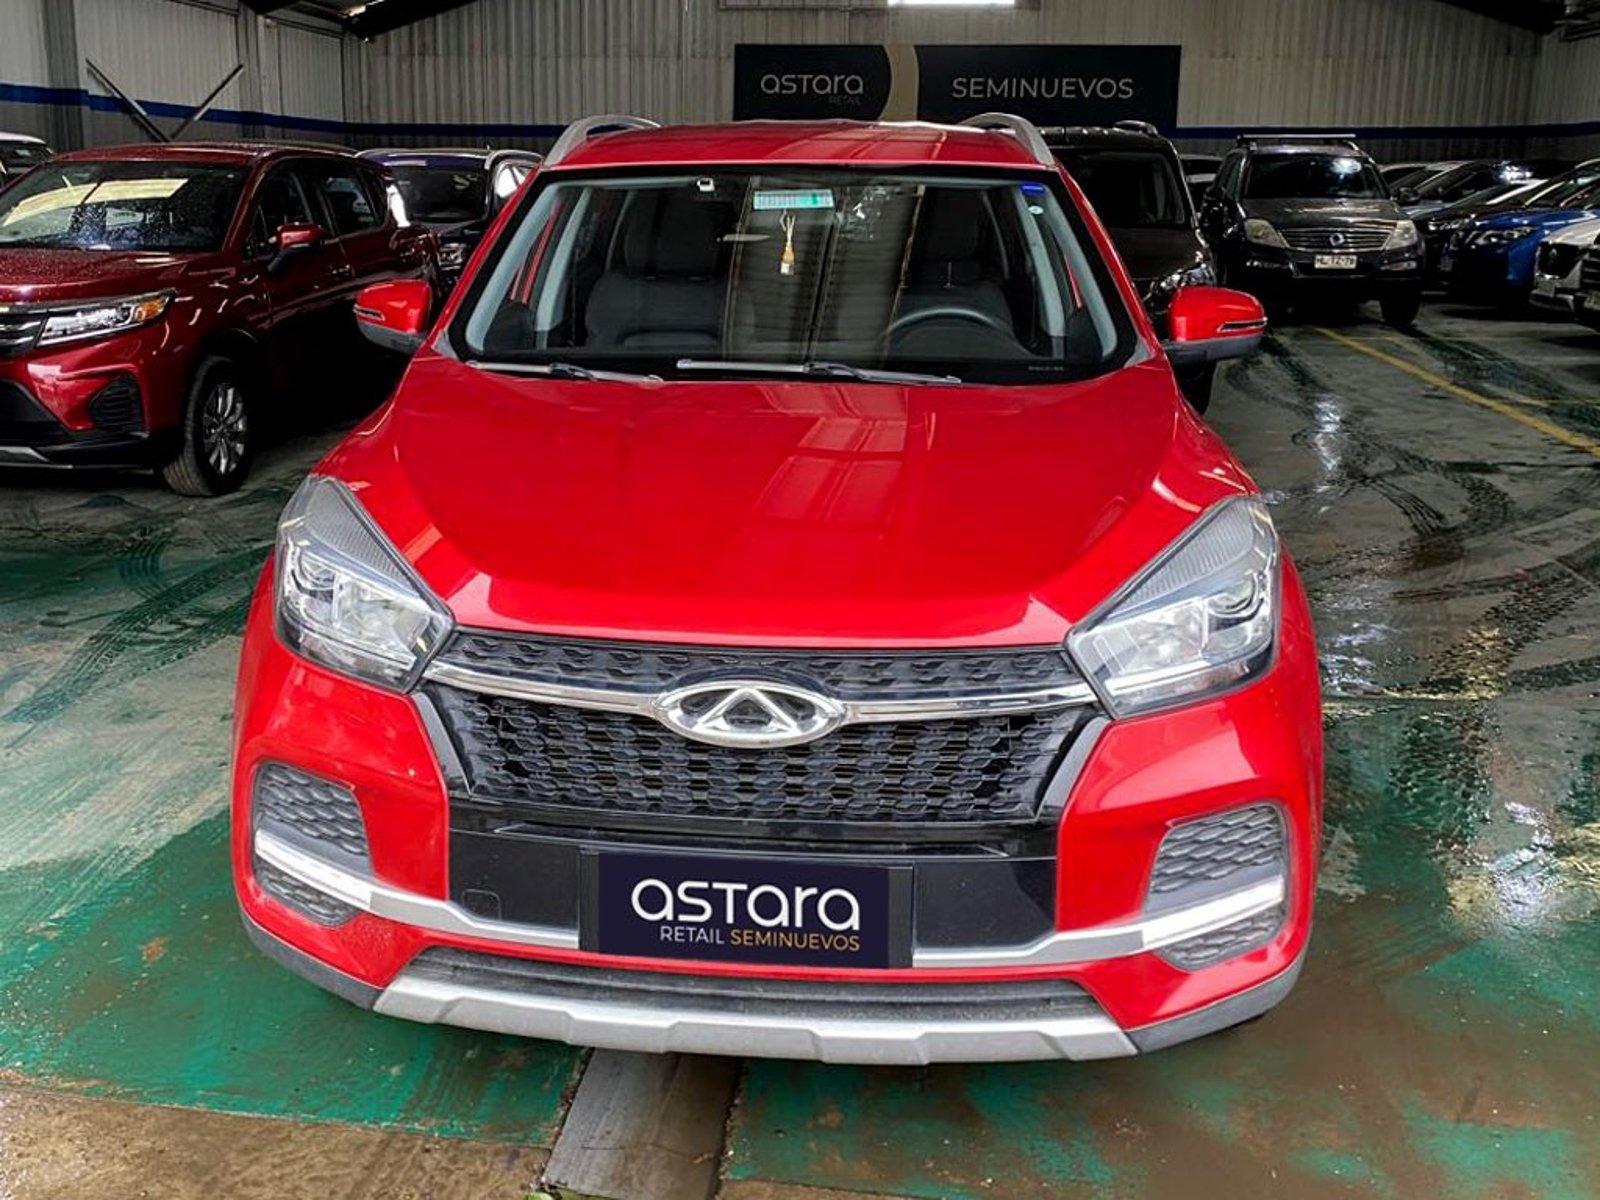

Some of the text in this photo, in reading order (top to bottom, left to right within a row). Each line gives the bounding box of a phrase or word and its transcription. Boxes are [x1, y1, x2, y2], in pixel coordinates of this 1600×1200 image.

[760, 74, 864, 95] astara
[952, 77, 1134, 99] SEMINUEVOS
[631, 878, 861, 930] astara
[660, 925, 861, 951] RETAIL SEMINUEVOS
